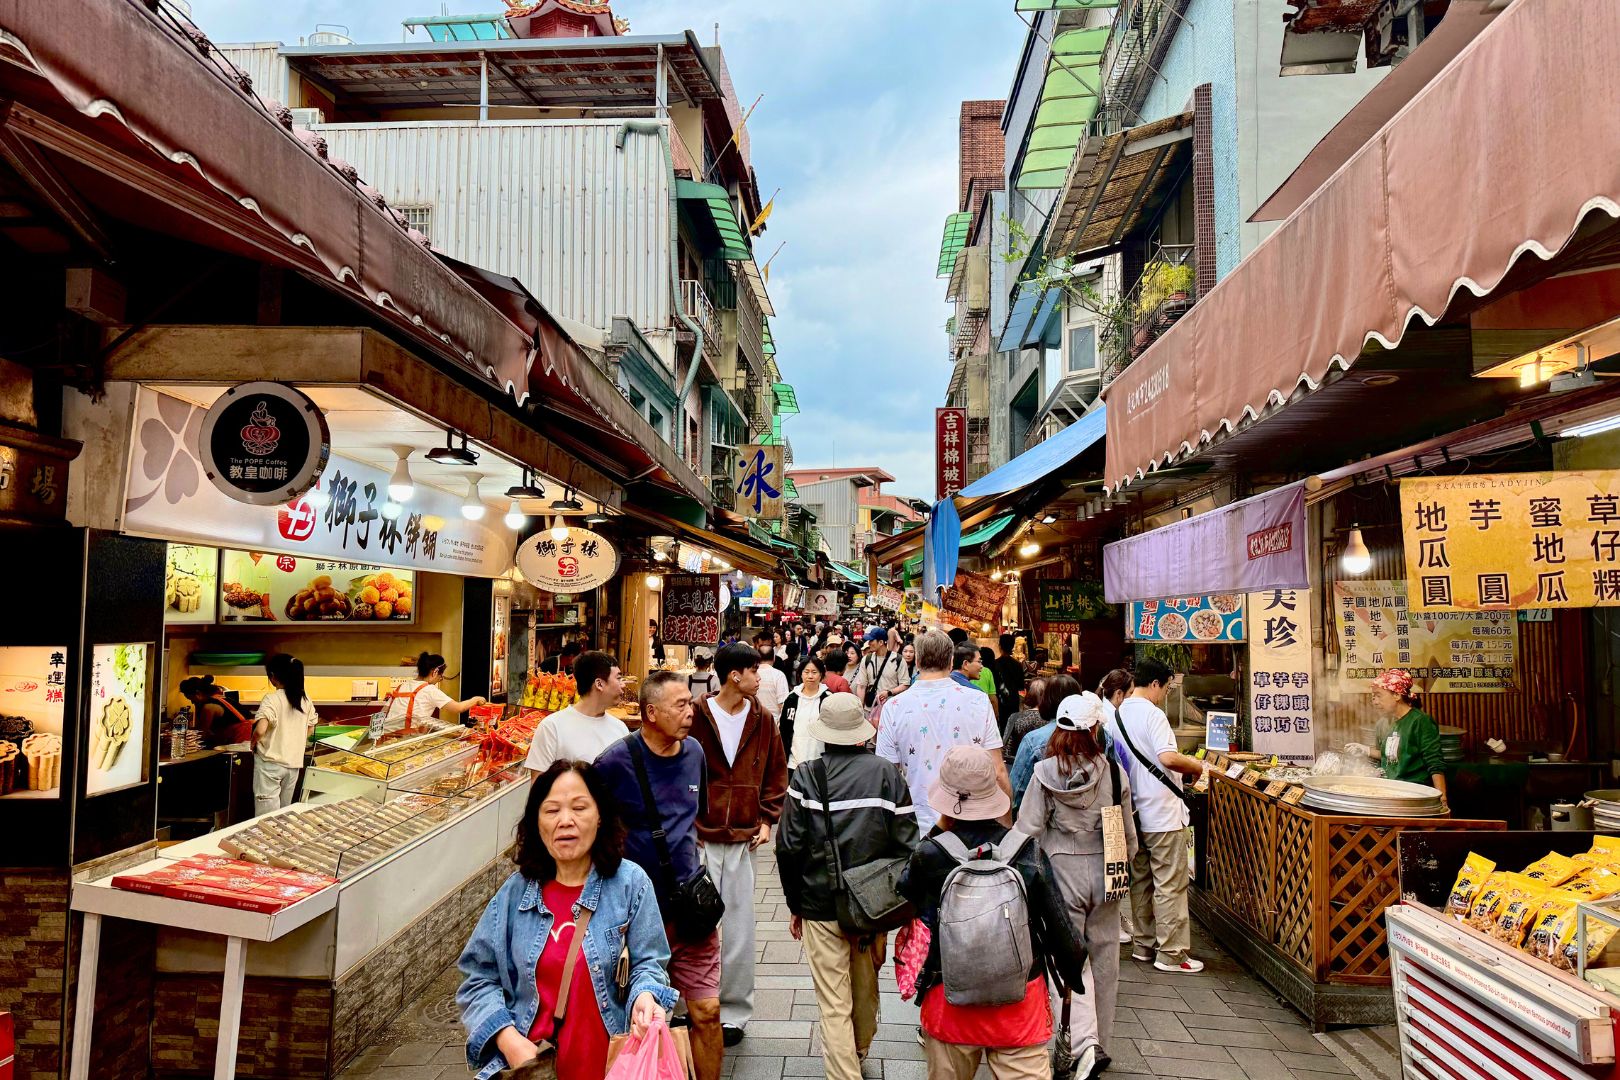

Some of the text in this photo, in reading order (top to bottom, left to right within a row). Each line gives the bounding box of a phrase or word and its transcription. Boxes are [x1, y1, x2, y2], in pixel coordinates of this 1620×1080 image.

[229, 465, 288, 481] 教皇咖啡
[736, 449, 781, 514] 冰
[1414, 501, 1453, 607] 地瓜圓
[1529, 497, 1569, 602] 蜜地瓜
[1586, 494, 1620, 600] 草仔粿
[1292, 672, 1310, 734] 芋頭包
[1432, 667, 1472, 679] 天然手作
